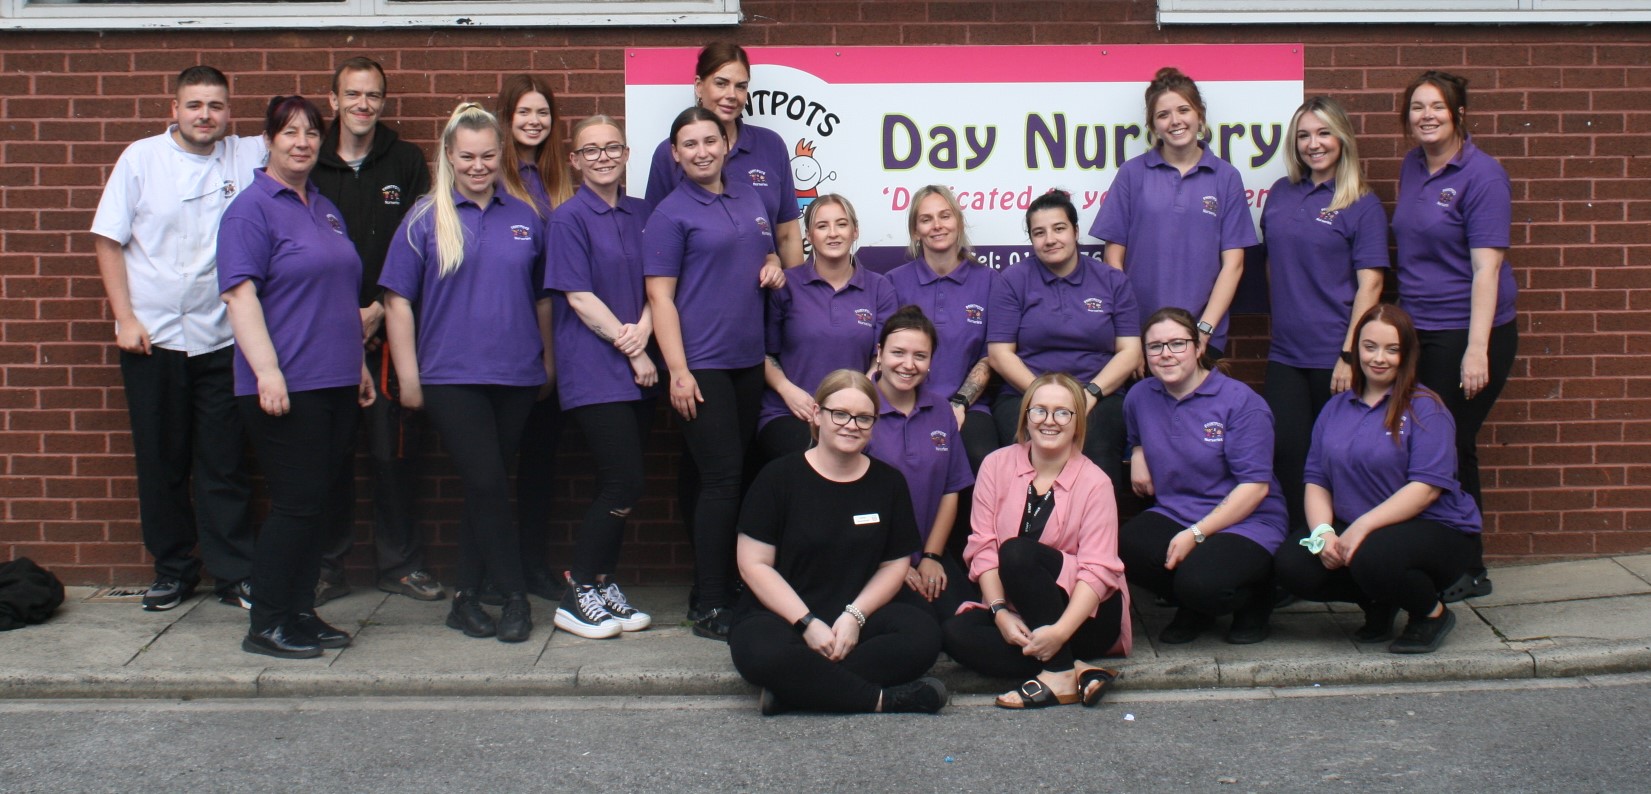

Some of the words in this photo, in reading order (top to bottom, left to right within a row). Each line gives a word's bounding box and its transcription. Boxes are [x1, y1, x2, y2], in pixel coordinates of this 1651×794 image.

[741, 89, 841, 137] NTPOTS
[881, 113, 997, 171] Day
[1024, 112, 1283, 170] Nurry
[970, 251, 1000, 269] el:
